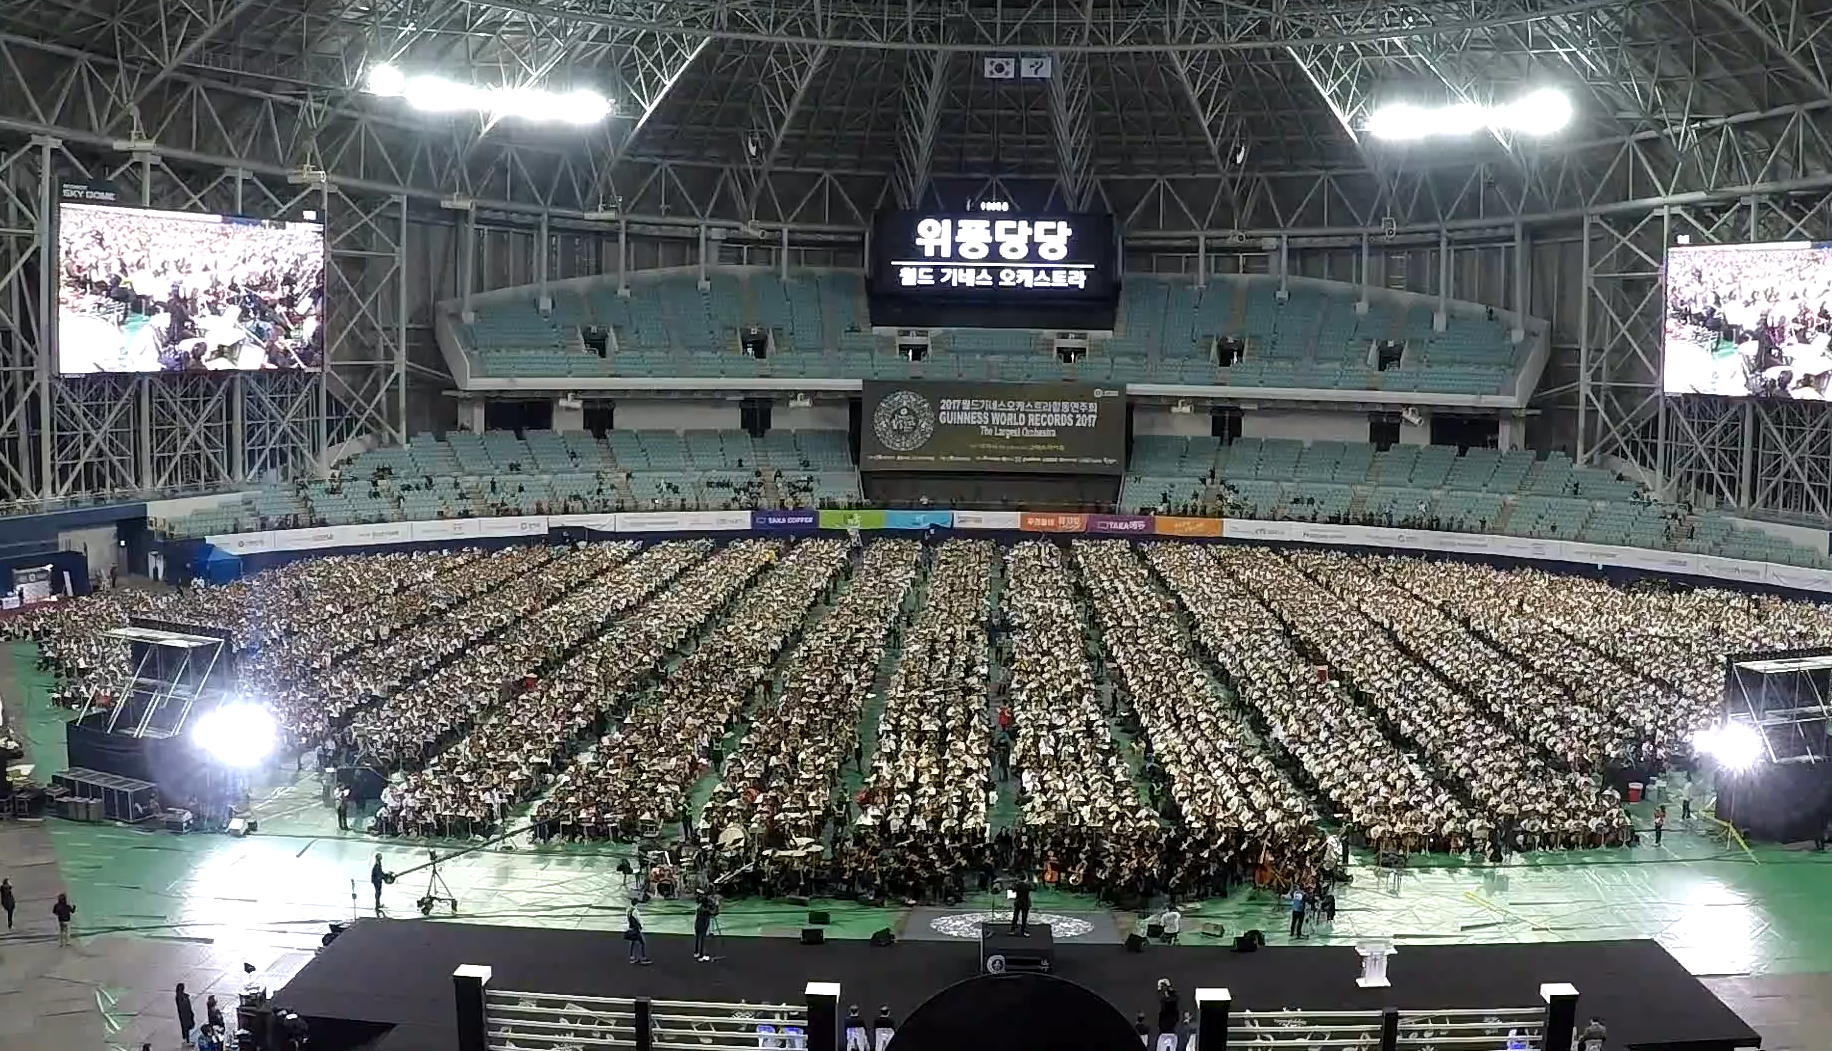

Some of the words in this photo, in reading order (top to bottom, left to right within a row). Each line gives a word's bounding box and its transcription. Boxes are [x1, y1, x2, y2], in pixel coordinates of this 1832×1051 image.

[915, 218, 1072, 260] 위풍당당
[899, 267, 935, 286] 월드
[940, 267, 993, 287] 기네스
[999, 268, 1086, 289] 오케스트라
[939, 411, 989, 425] GUINNESS
[991, 412, 1026, 426] WORLD
[1028, 413, 1074, 427] RECORDS
[1075, 414, 1097, 428] 2017
[980, 425, 993, 436] The
[994, 426, 1020, 439] Largest
